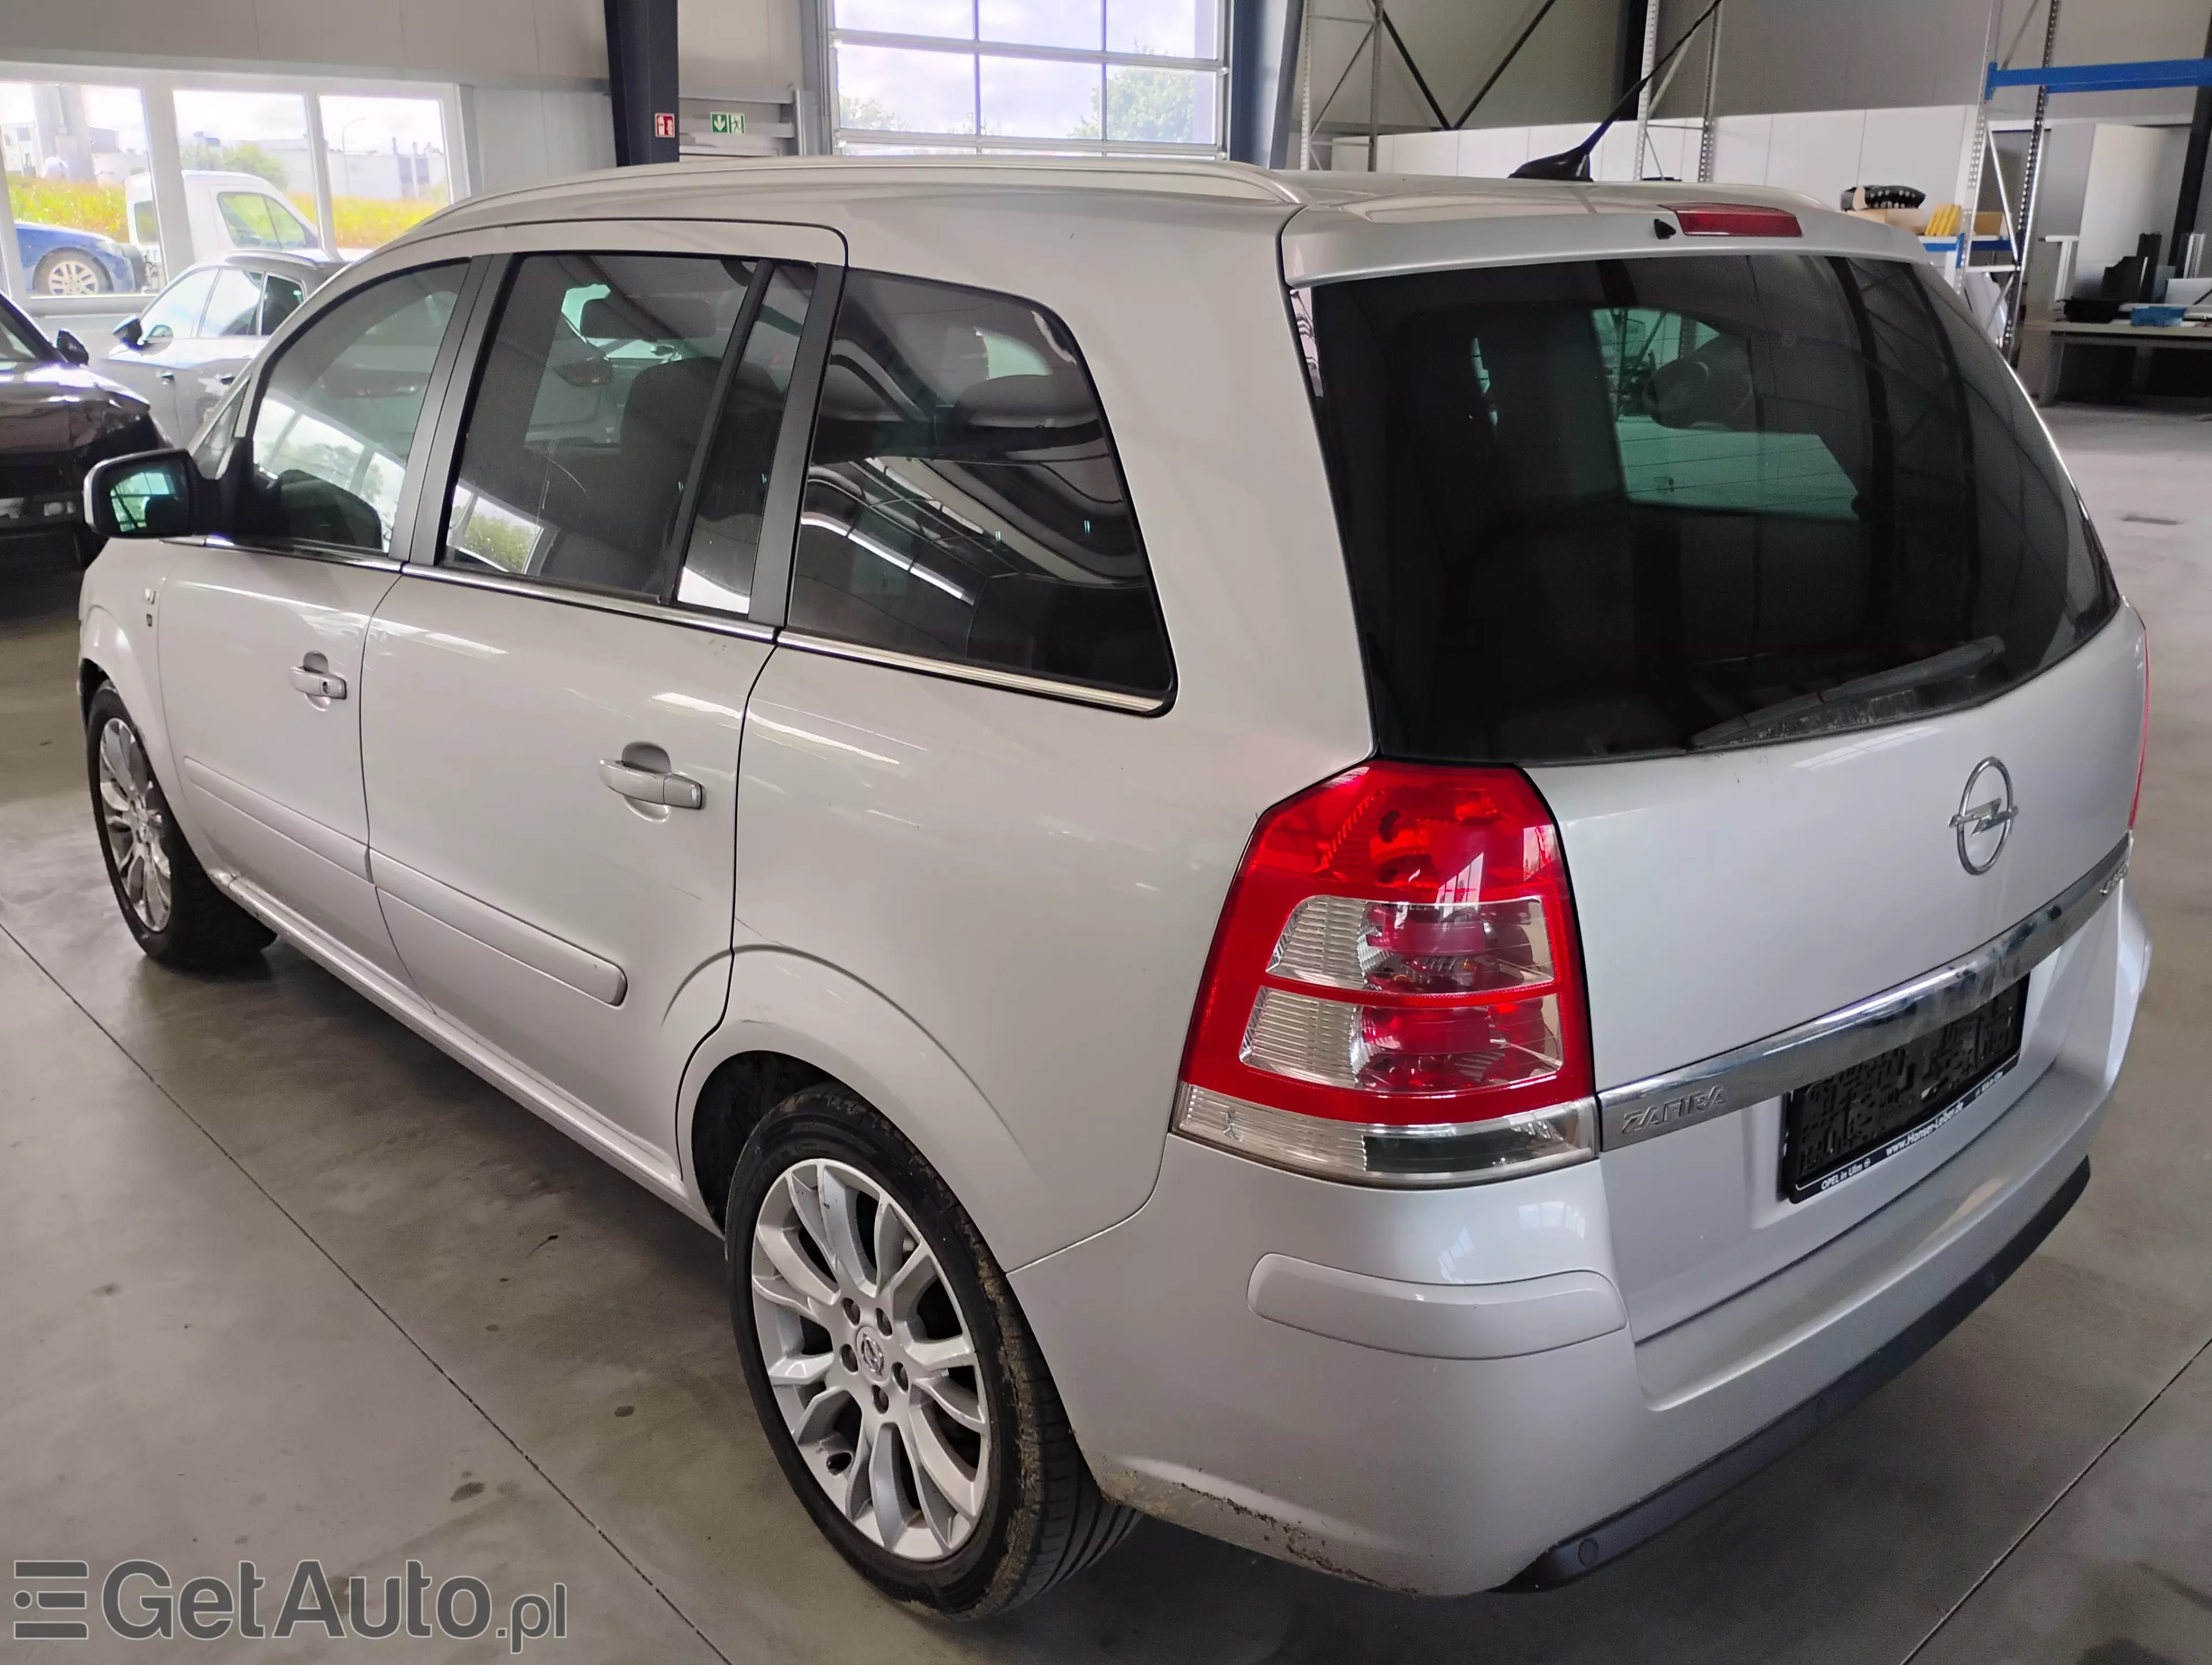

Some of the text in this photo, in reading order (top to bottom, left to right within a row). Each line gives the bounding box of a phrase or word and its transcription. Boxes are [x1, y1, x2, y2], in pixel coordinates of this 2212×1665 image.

[1622, 1085, 1726, 1133] ZAFIRA
[1821, 1174, 1840, 1190] OPEL
[1840, 1171, 1847, 1179] in
[1848, 1163, 1863, 1177] Ulm
